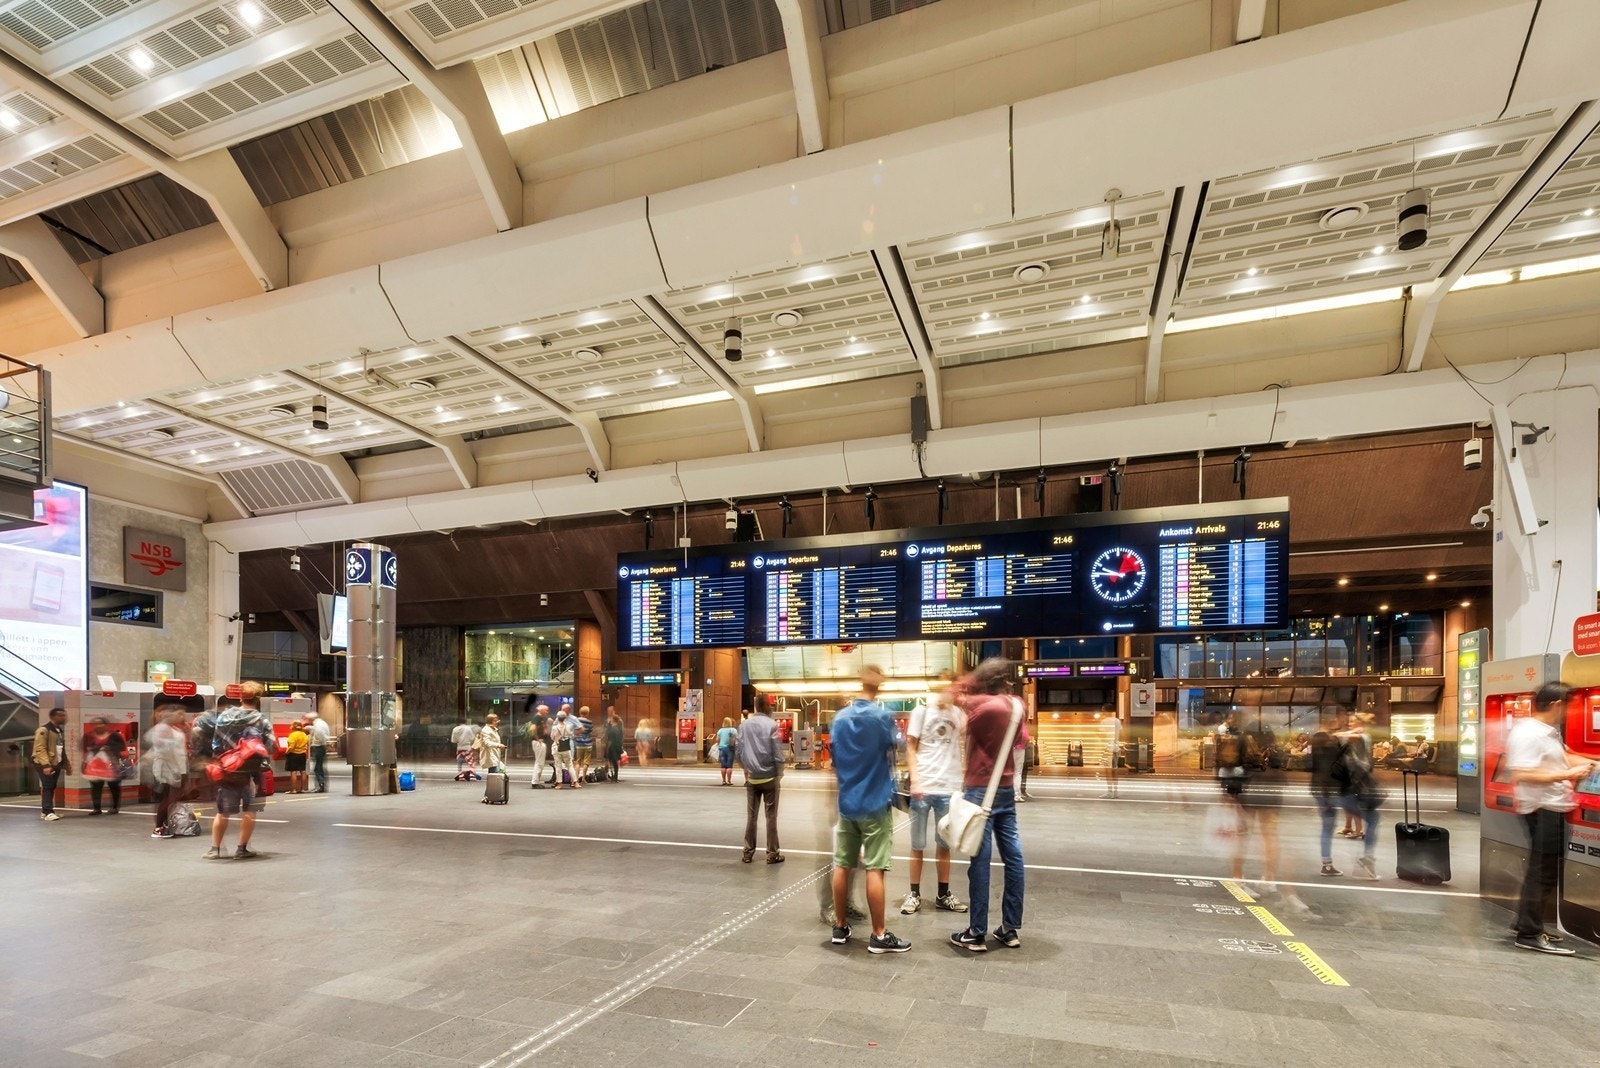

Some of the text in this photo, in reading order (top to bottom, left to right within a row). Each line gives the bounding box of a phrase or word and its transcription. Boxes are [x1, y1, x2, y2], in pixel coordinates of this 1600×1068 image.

[1160, 525, 1226, 536] Ankomst Arrivals
[141, 541, 172, 558] NSB
[922, 543, 982, 554] Avgang Departures
[766, 558, 786, 566] Avgang
